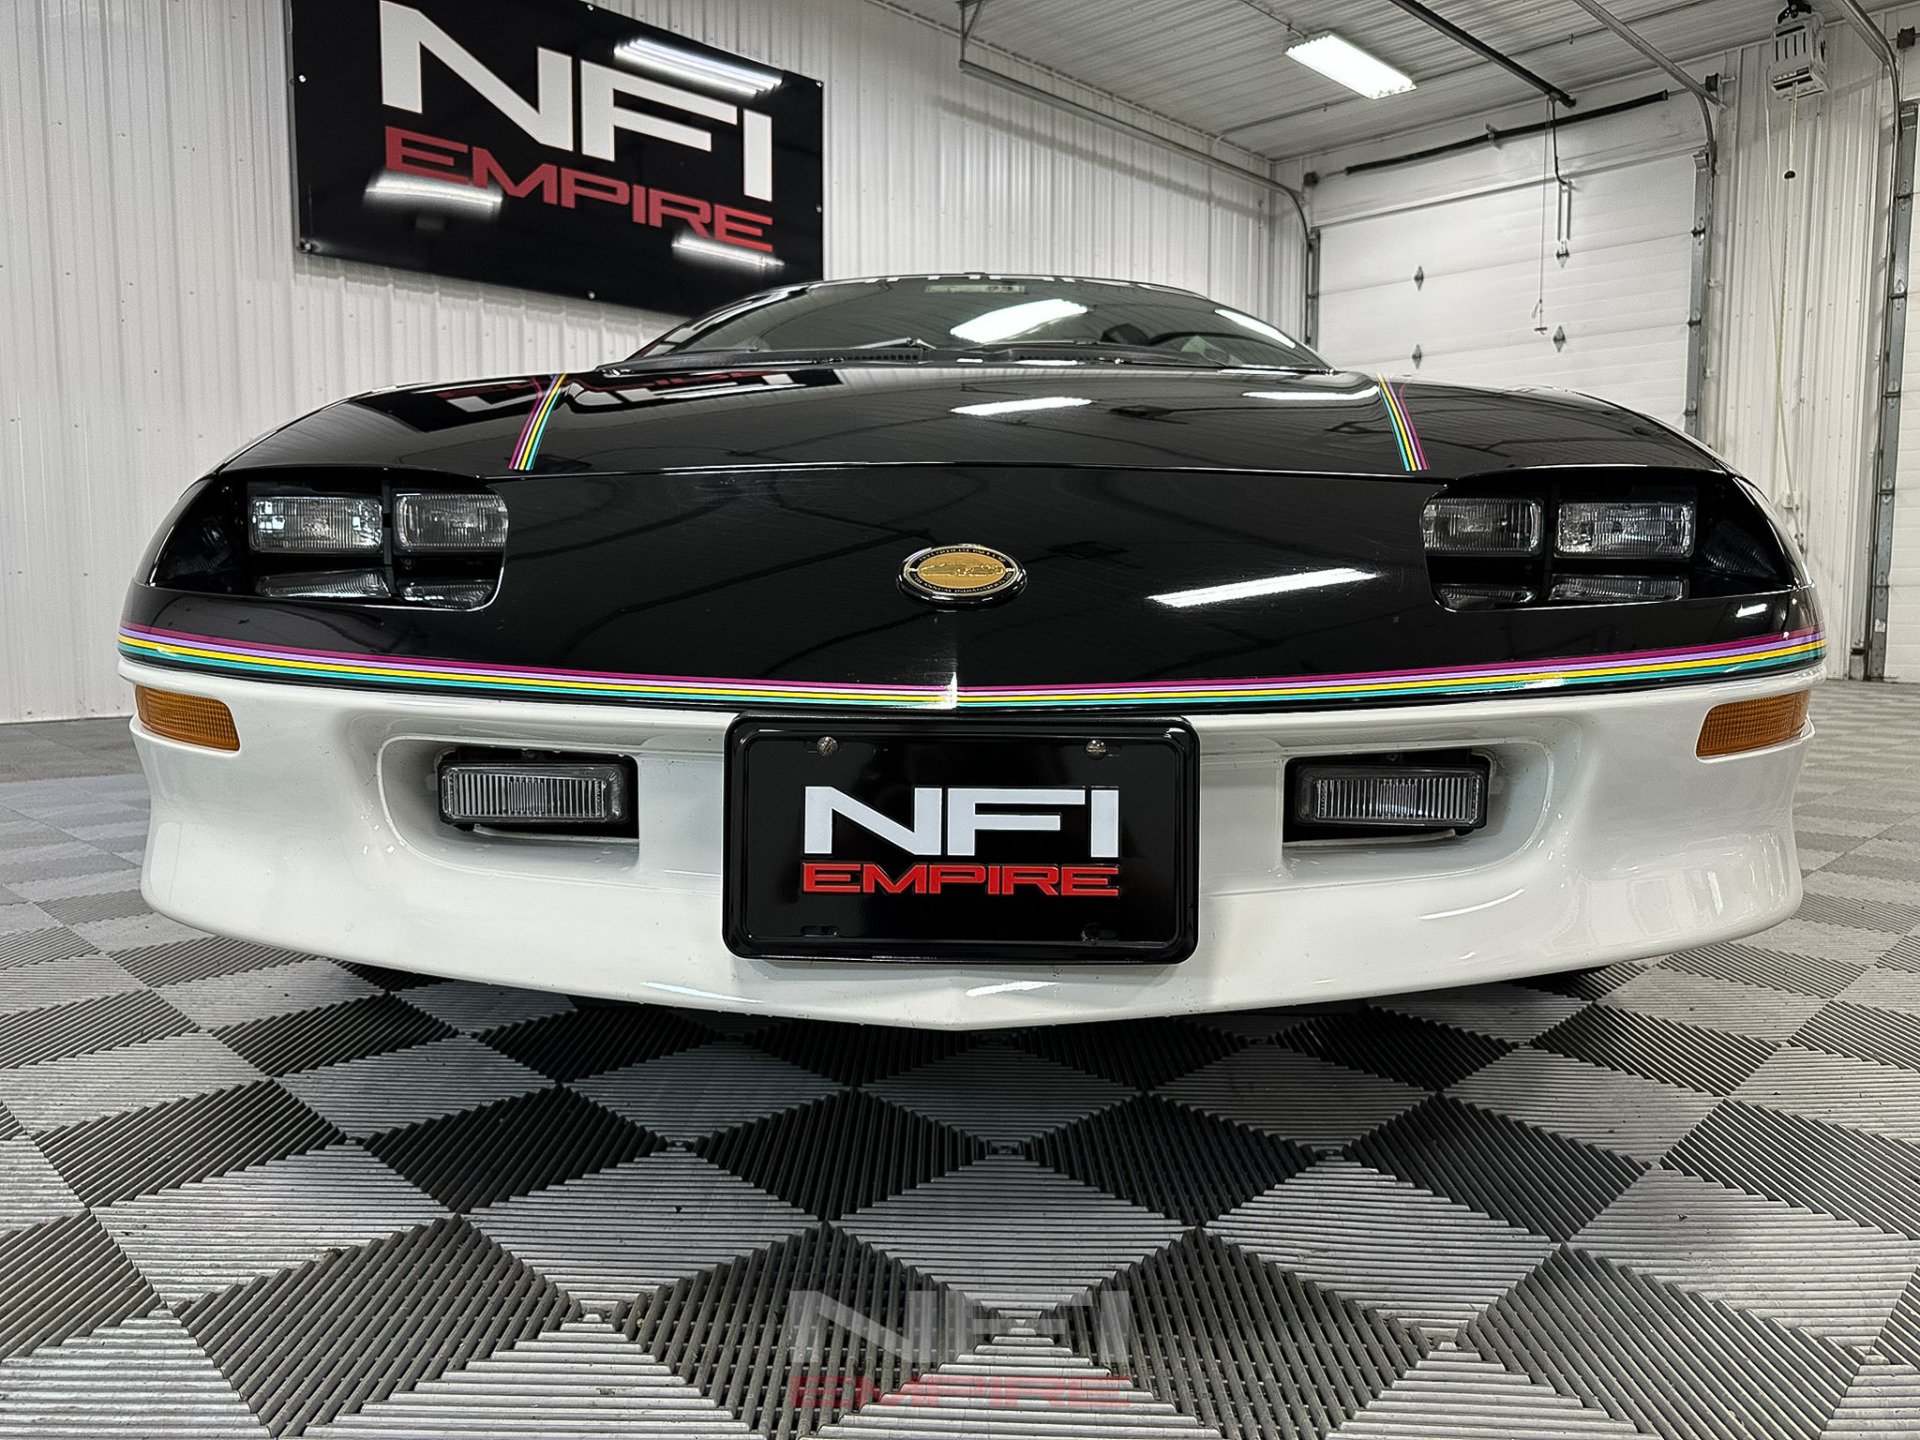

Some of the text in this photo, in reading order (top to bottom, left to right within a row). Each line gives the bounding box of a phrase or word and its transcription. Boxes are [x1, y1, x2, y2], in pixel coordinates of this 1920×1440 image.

[379, 0, 774, 202] NFI
[385, 125, 774, 252] EMPIRE
[803, 785, 1120, 858] NFI
[802, 862, 1120, 897] EMPIRE
